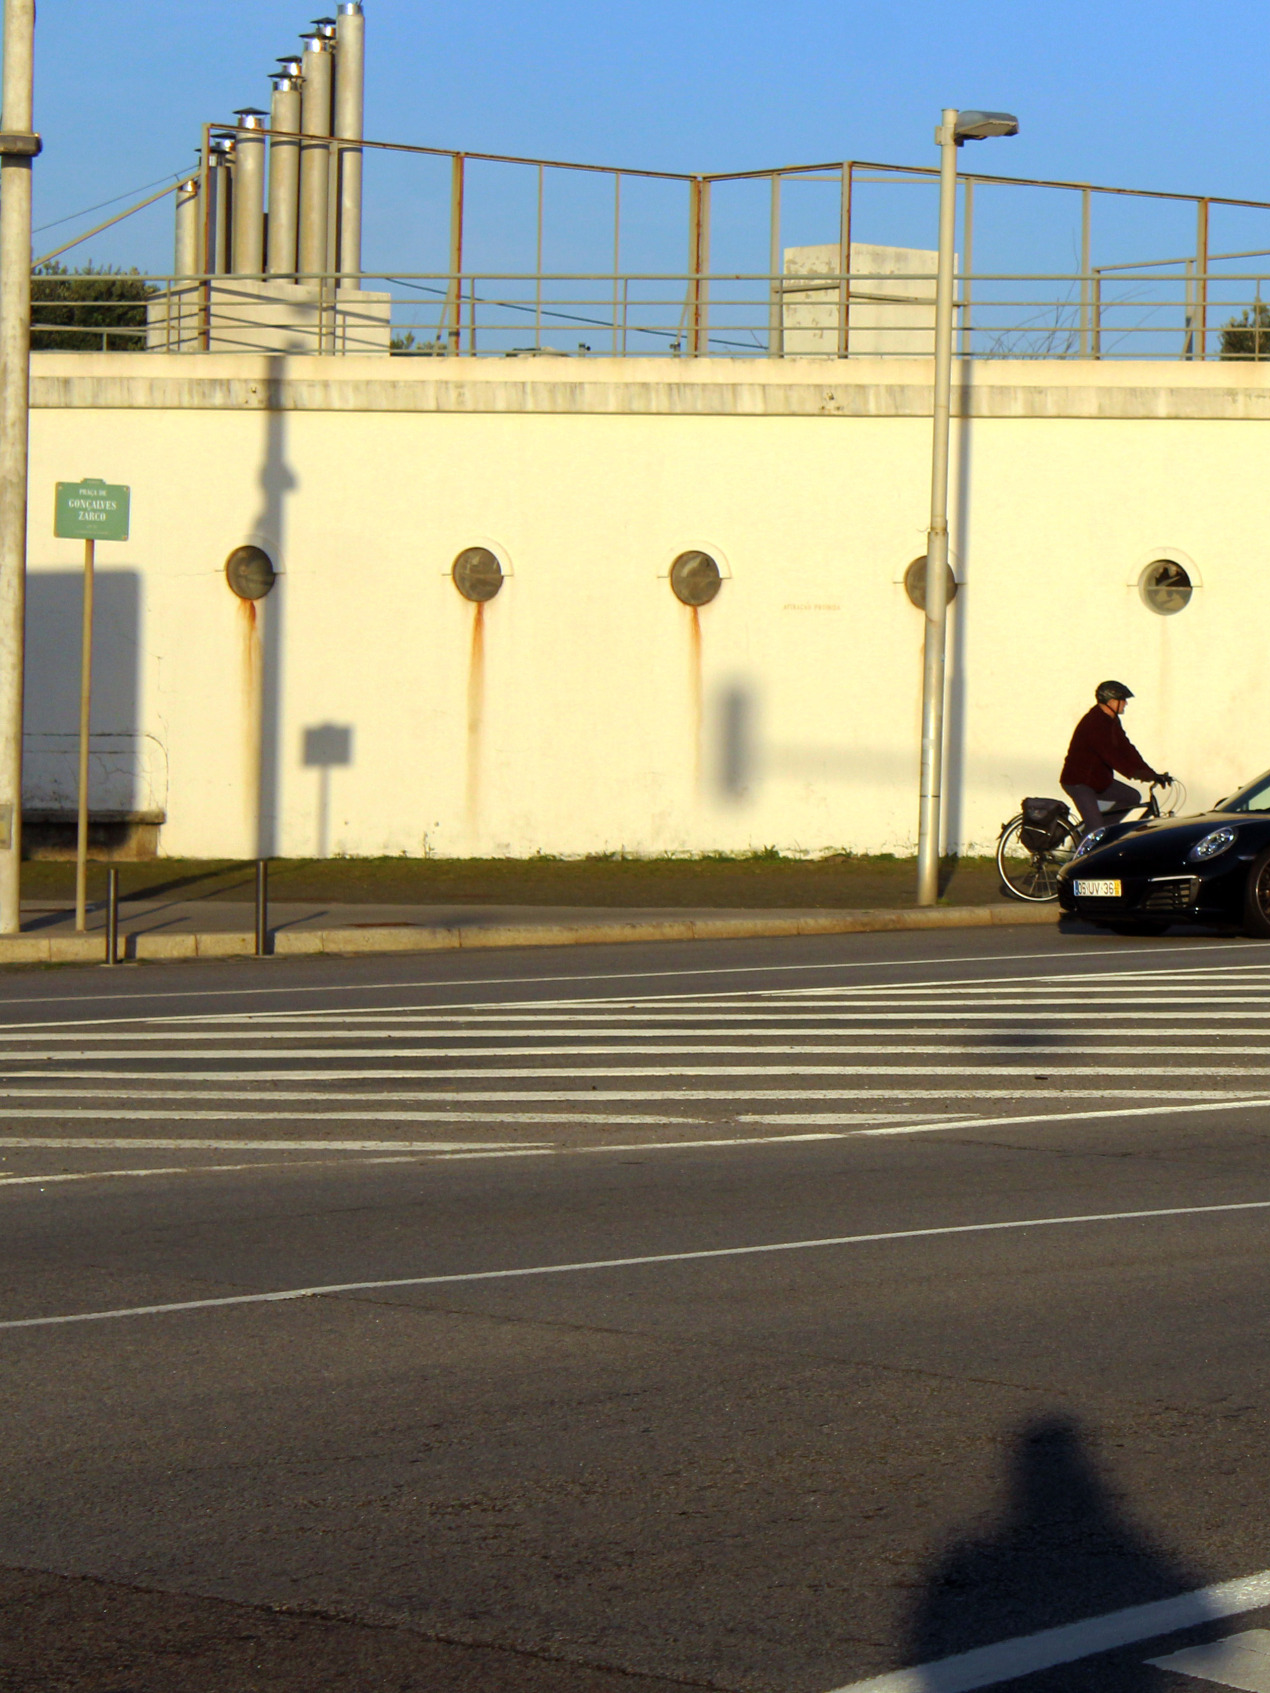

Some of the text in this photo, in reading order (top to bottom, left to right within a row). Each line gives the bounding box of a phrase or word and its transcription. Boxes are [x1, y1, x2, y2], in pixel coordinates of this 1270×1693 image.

[79, 488, 108, 497] PRAÇA DE
[68, 498, 117, 510] GONÇALVES
[78, 510, 106, 521] ZARCO
